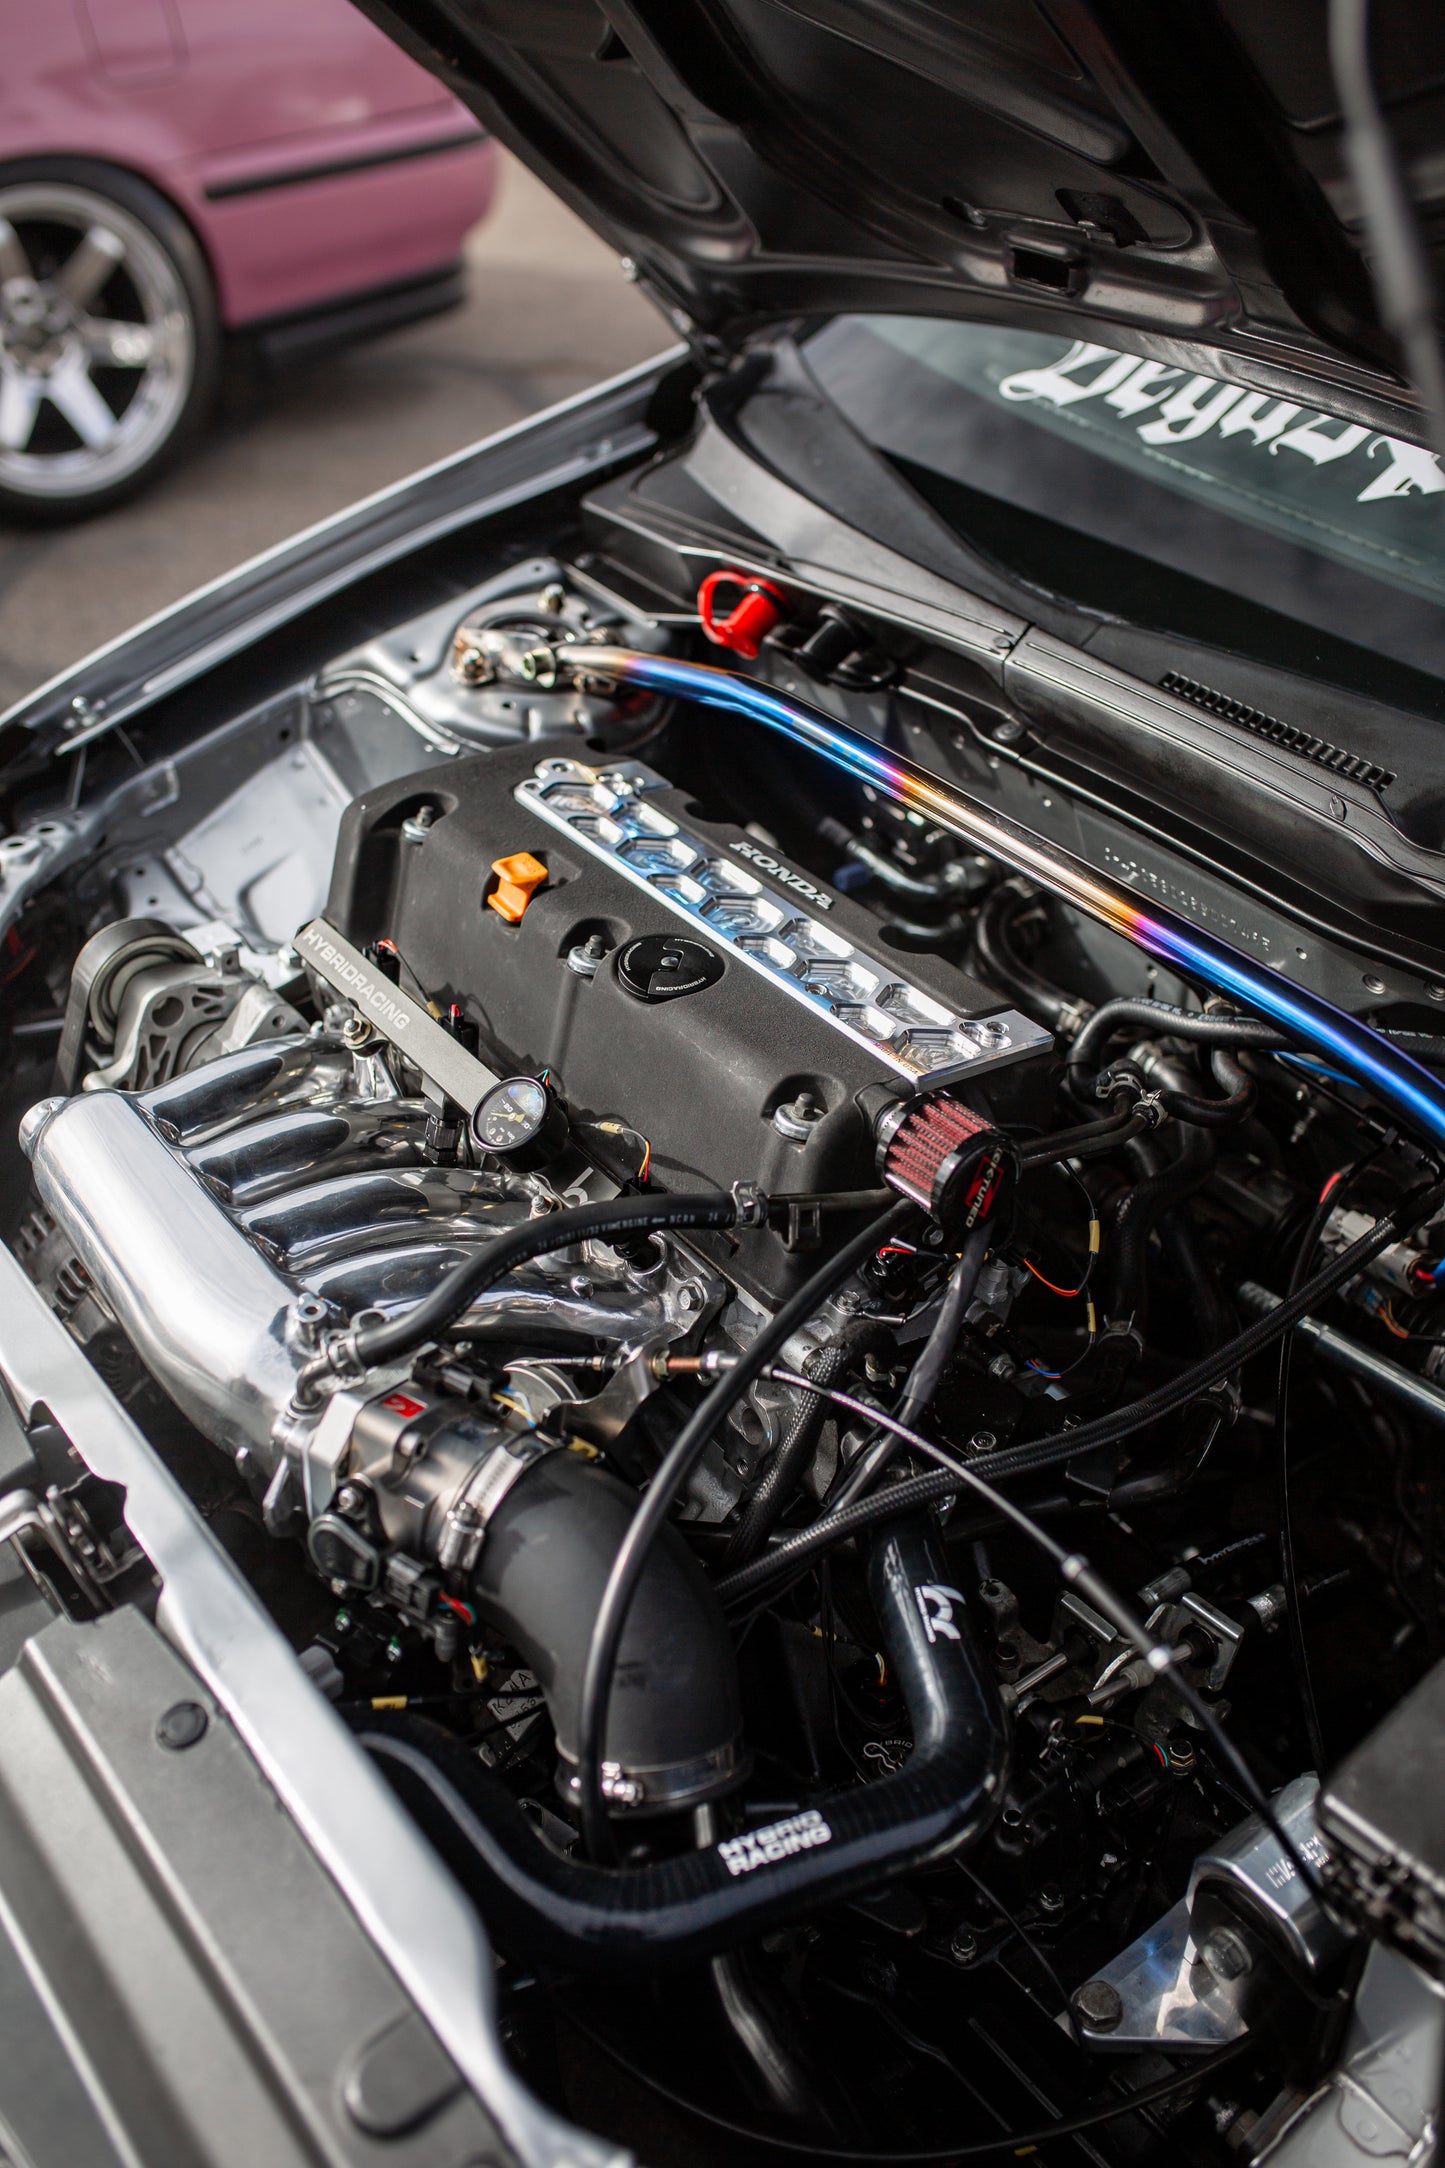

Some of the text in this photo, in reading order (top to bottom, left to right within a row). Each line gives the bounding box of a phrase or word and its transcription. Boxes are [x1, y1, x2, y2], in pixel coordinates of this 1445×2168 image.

[729, 841, 836, 910] HONDA
[303, 928, 410, 1030] HYBRIDRACING
[717, 1809, 823, 1859] HYBRID
[725, 1822, 832, 1876] RACING
